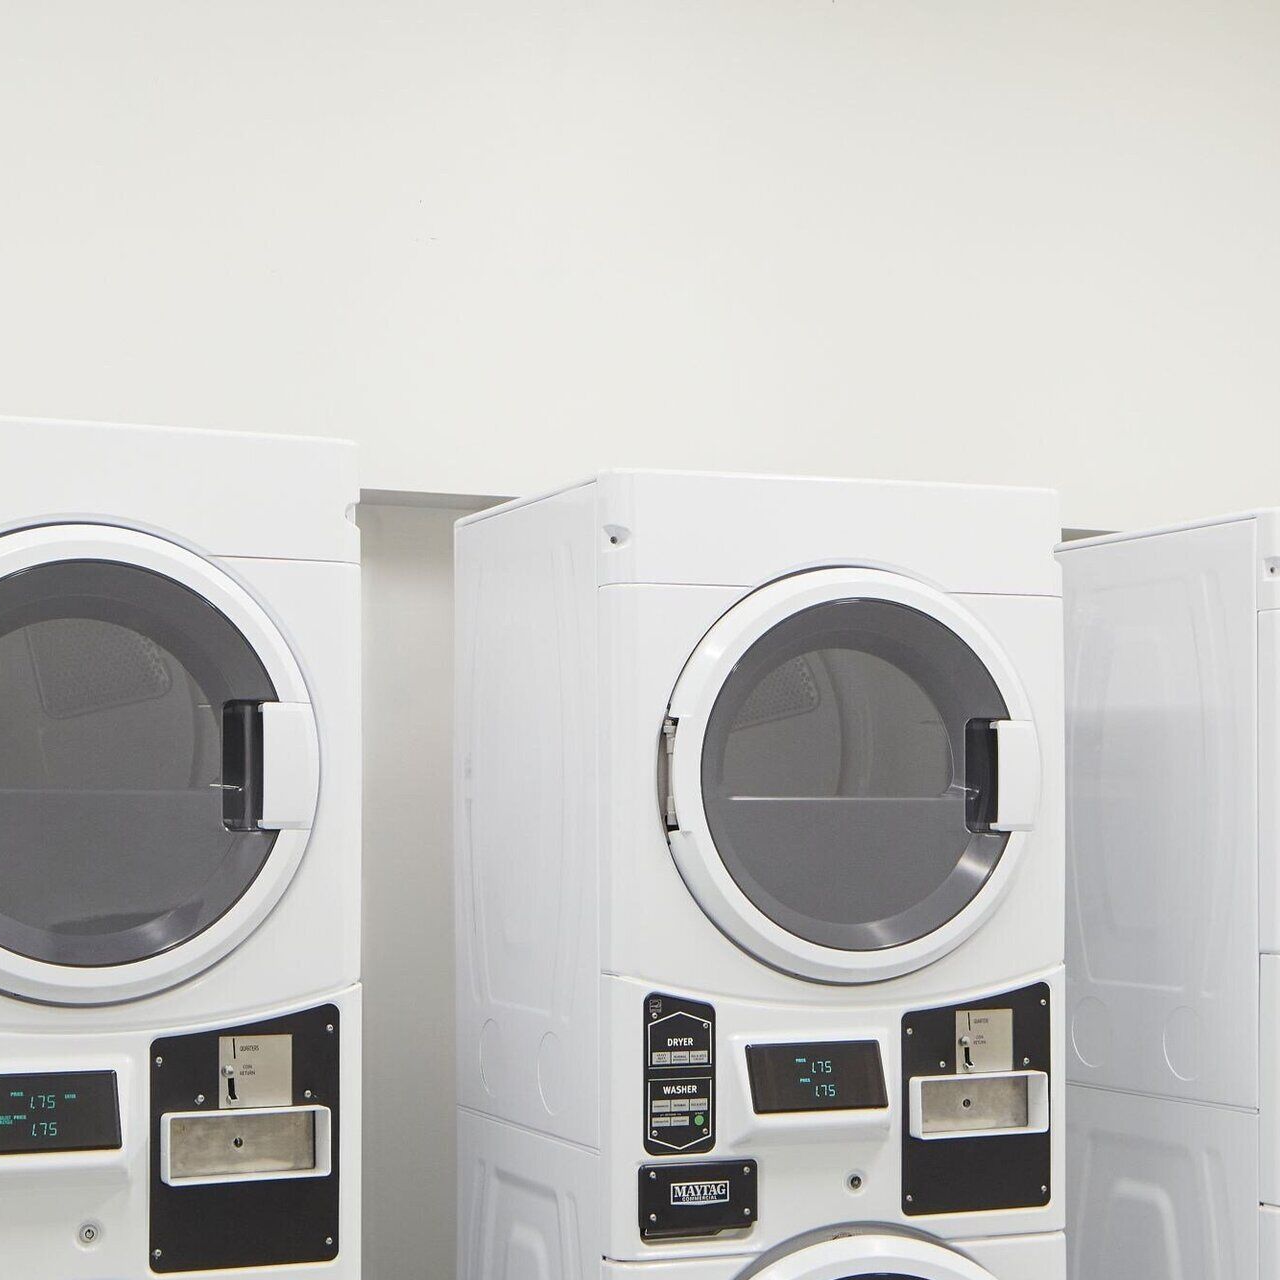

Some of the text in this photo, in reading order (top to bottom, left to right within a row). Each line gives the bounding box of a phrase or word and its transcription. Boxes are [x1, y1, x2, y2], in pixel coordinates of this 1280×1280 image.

[667, 1037, 694, 1047] DRYER
[662, 1085, 698, 1095] WASHER
[29, 1095, 56, 1109] 1.75
[31, 1122, 57, 1137] 1.75
[673, 1183, 726, 1198] MAYTAG
